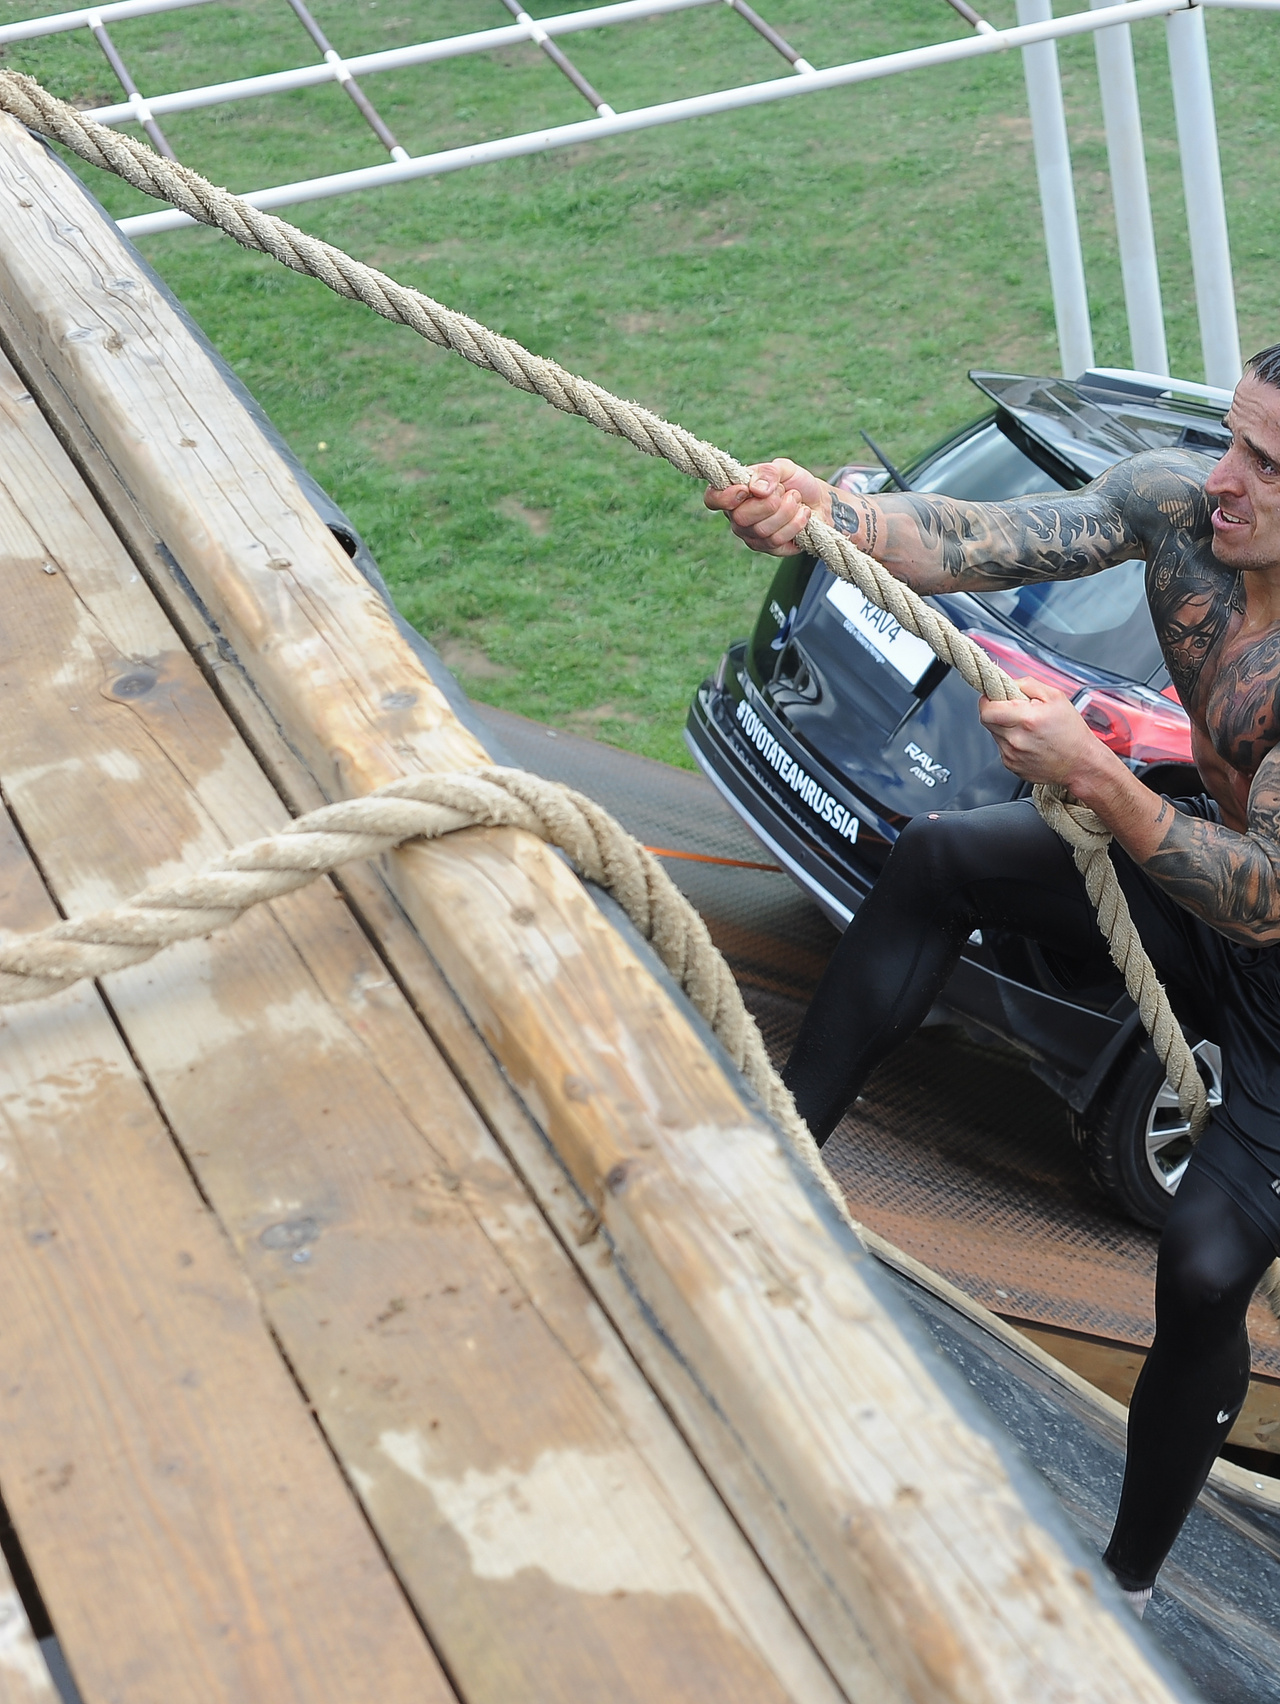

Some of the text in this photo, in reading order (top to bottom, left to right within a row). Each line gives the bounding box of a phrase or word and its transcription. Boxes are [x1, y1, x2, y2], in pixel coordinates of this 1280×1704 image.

[736, 699, 860, 845] #TOYOTATEAMRUSSIA
[903, 742, 952, 784] RAV4
[909, 765, 937, 788] AWD
